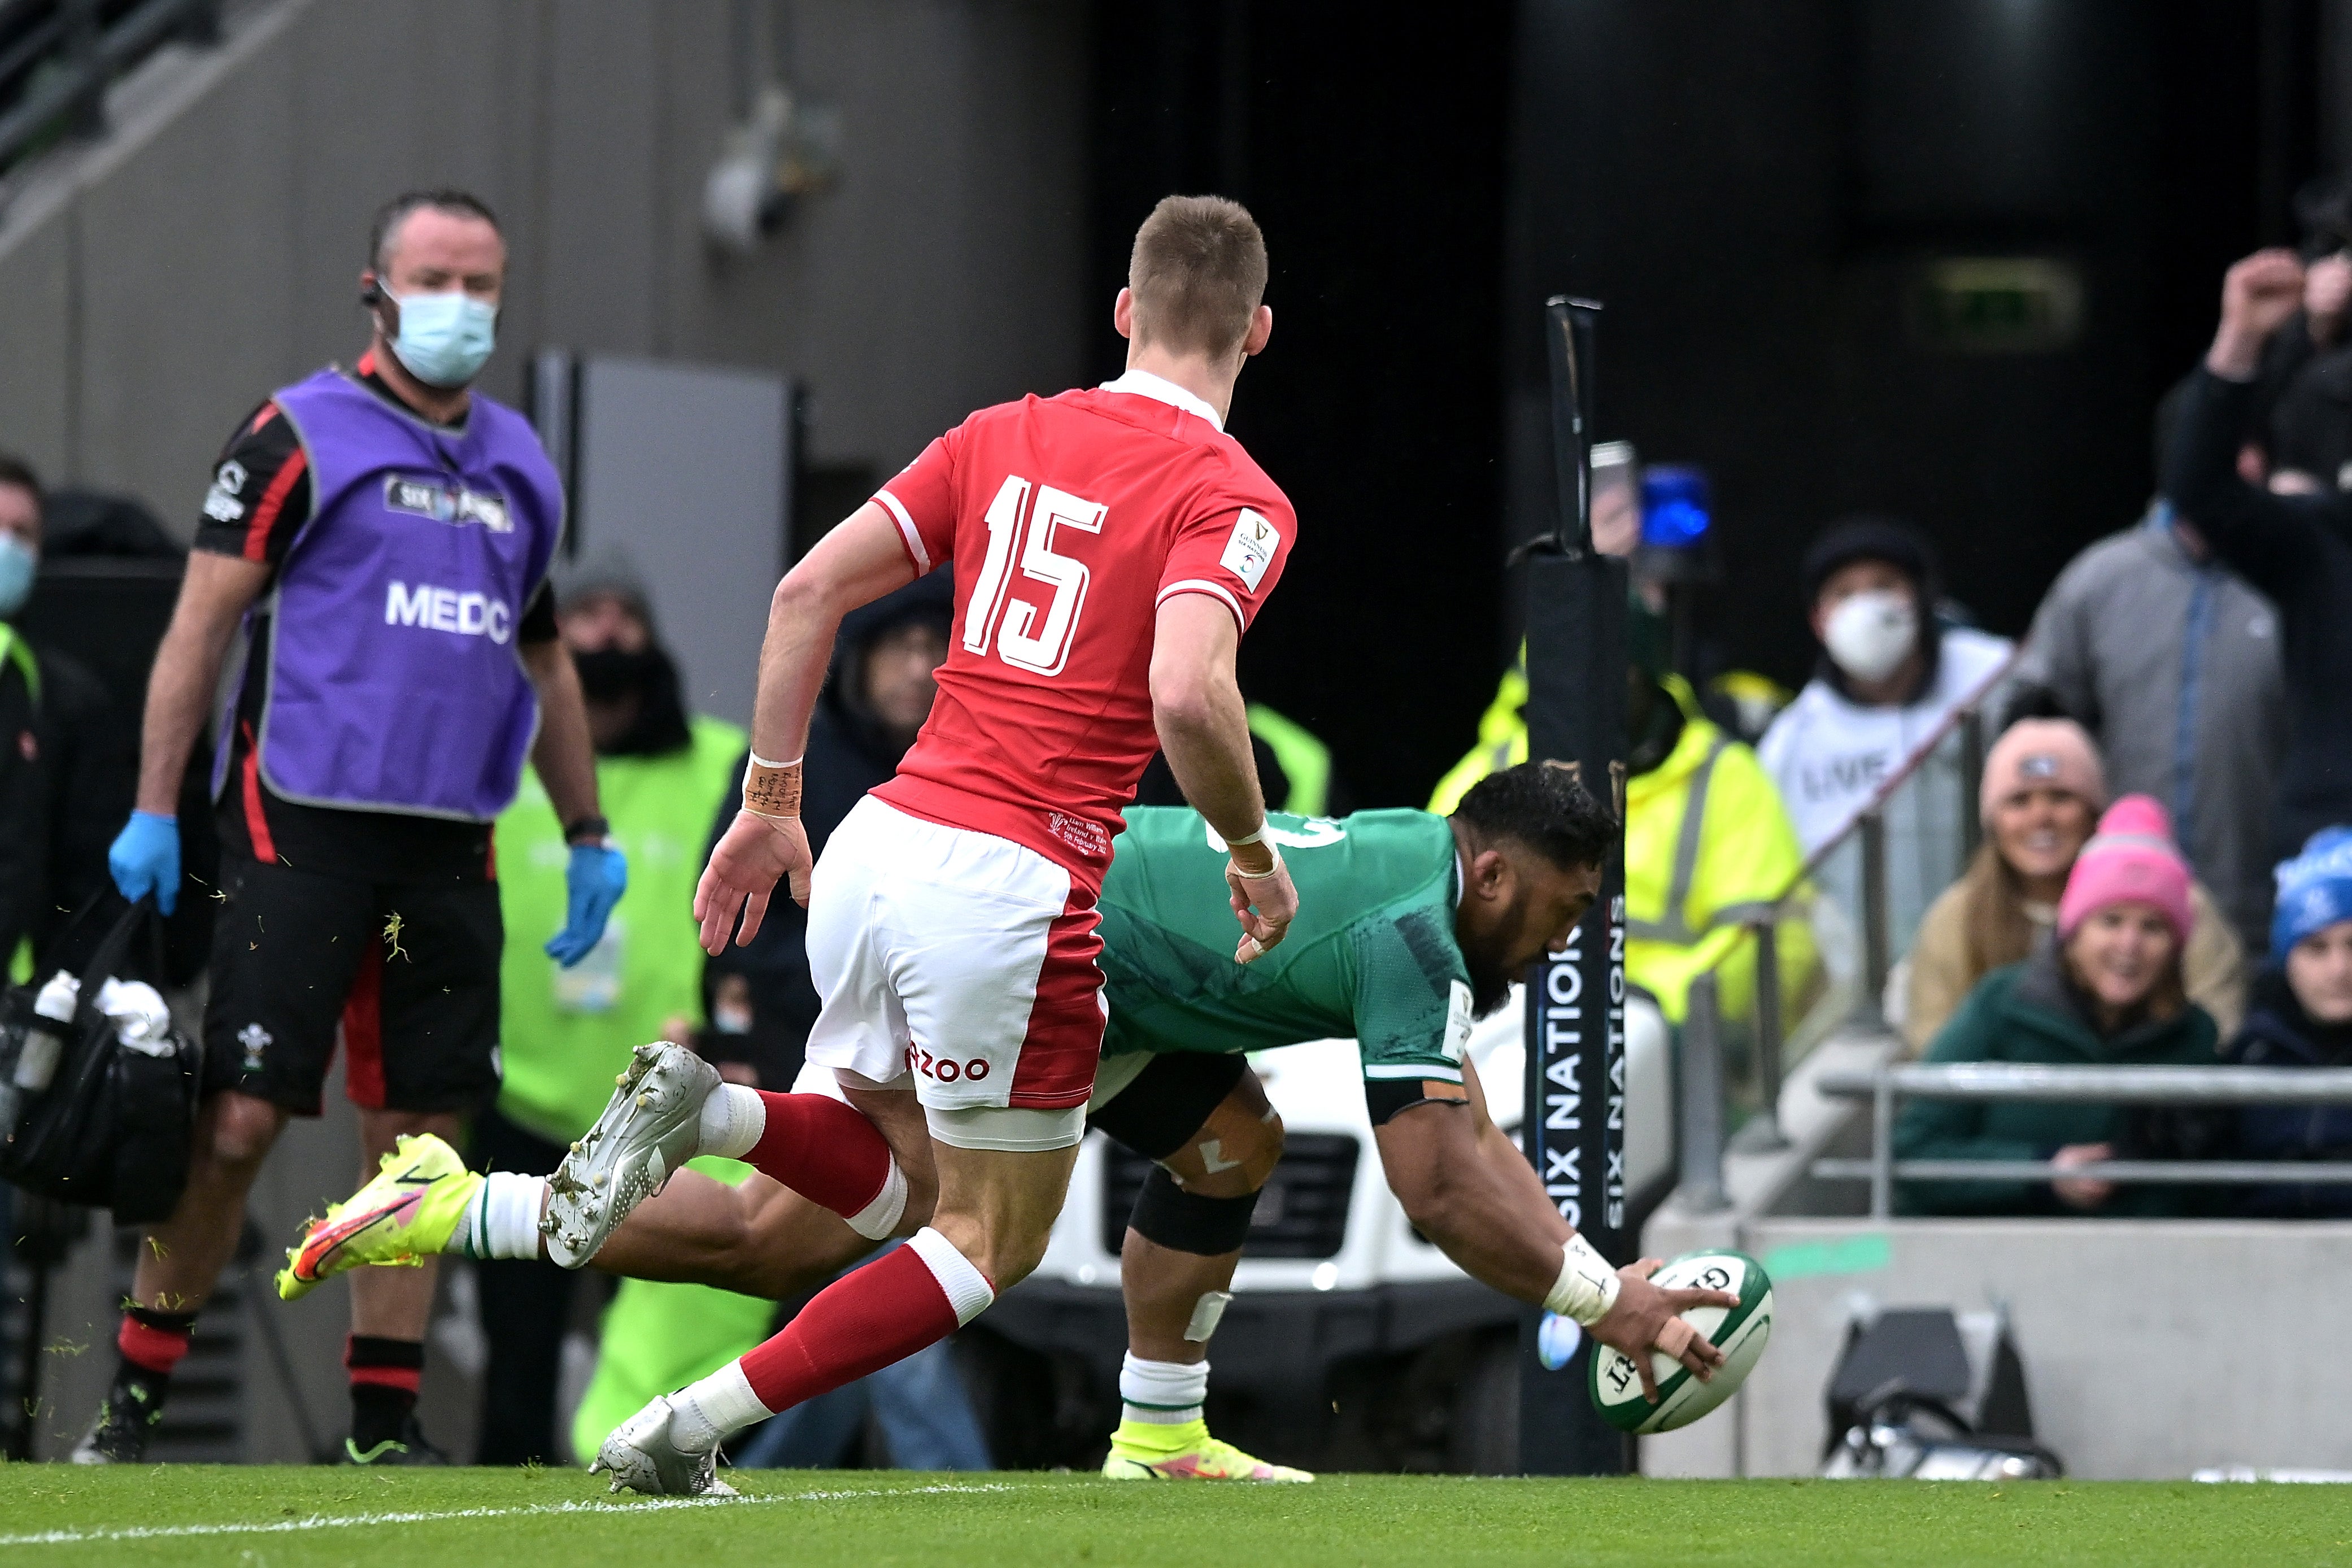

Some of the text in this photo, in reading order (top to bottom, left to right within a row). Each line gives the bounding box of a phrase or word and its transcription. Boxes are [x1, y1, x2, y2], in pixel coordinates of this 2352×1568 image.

[1240, 533, 1267, 557] GUINNESS
[1247, 545, 1265, 563] NATIONS
[962, 474, 1109, 677] 15
[385, 581, 511, 645] MEDC
[1066, 824, 1089, 838] Ireland
[1074, 835, 1097, 852] February
[1608, 894, 1625, 1230] SIX NATIONS
[1545, 1146, 1581, 1229] SIX
